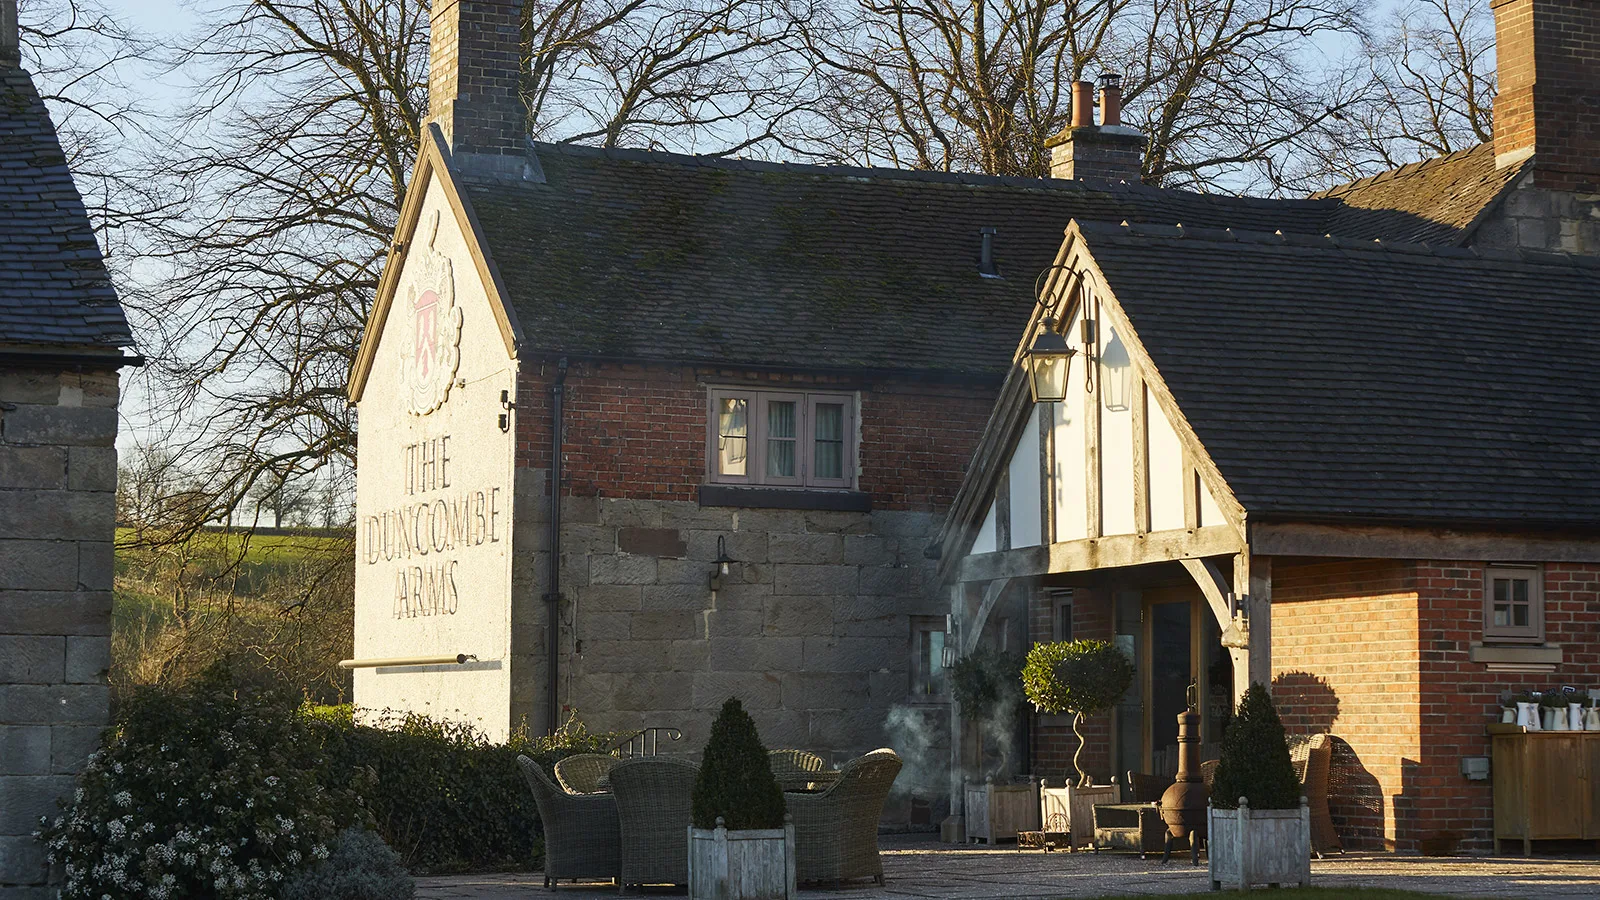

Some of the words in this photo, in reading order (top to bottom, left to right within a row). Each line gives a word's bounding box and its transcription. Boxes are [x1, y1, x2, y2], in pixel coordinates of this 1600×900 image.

[402, 435, 451, 496] THE
[362, 487, 500, 565] DUNCOMBE
[392, 560, 459, 619] ARMS
